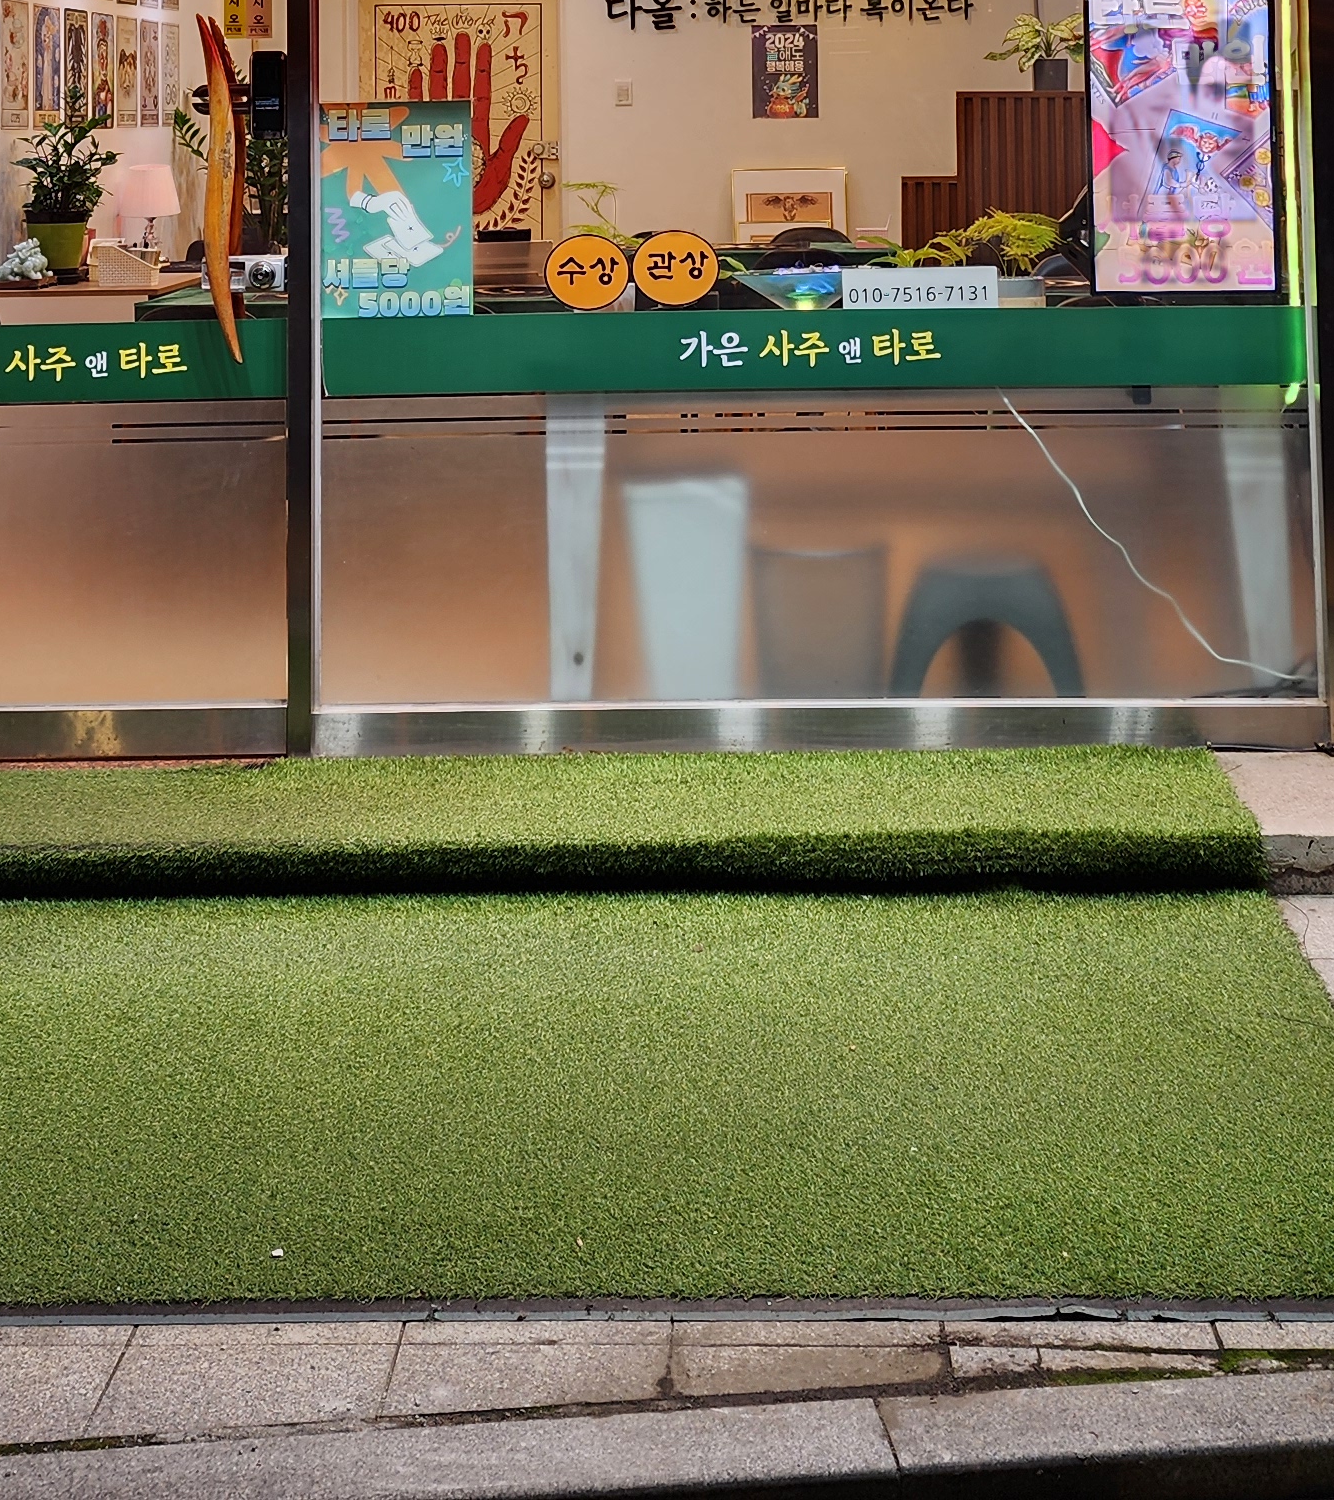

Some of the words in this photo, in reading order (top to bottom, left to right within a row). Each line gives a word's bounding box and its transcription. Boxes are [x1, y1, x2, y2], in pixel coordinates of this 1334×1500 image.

[383, 11, 421, 33] 400
[765, 33, 805, 49] 2024
[765, 46, 804, 61] 올해도
[328, 108, 391, 141] 타로
[401, 123, 464, 158] 만원
[322, 258, 410, 289] 셔플당
[556, 250, 620, 286] 수상
[646, 250, 710, 281] 관상
[358, 285, 470, 318] 5000원
[848, 284, 989, 304] 010-7516-7131
[4, 344, 77, 382] 사주
[84, 350, 109, 379] 앤
[118, 342, 189, 379] 타로
[678, 330, 749, 368] 가은
[759, 329, 831, 368] 사주
[838, 337, 863, 365] 앤
[872, 328, 942, 365] 타로
